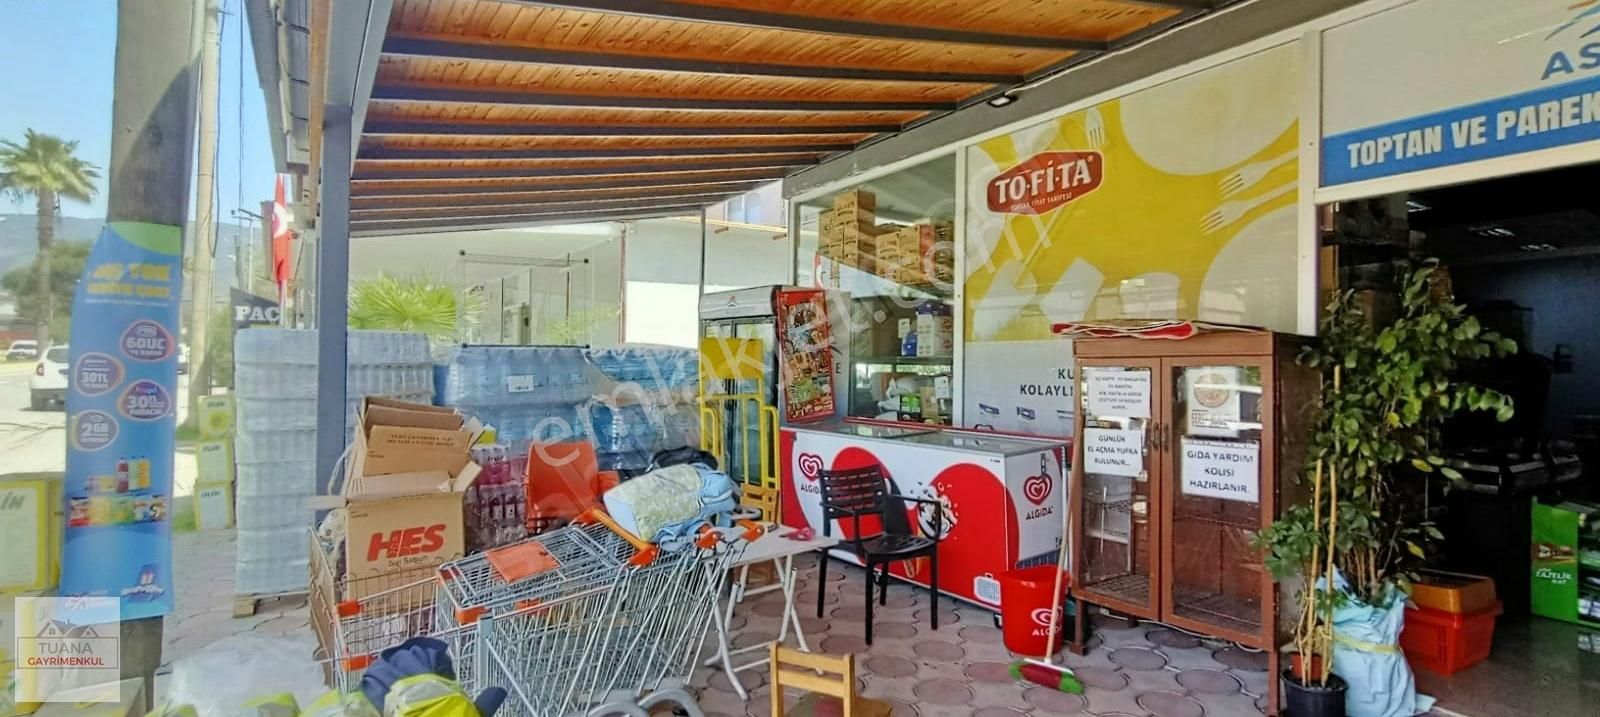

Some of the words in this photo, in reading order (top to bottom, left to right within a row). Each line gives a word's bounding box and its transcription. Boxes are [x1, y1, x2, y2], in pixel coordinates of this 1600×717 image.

[1347, 125, 1442, 169] TOPTAN
[1450, 116, 1487, 149] VE
[1496, 91, 1600, 141] PAREK
[1212, 452, 1254, 463] YARDIM
[367, 523, 447, 563] HES
